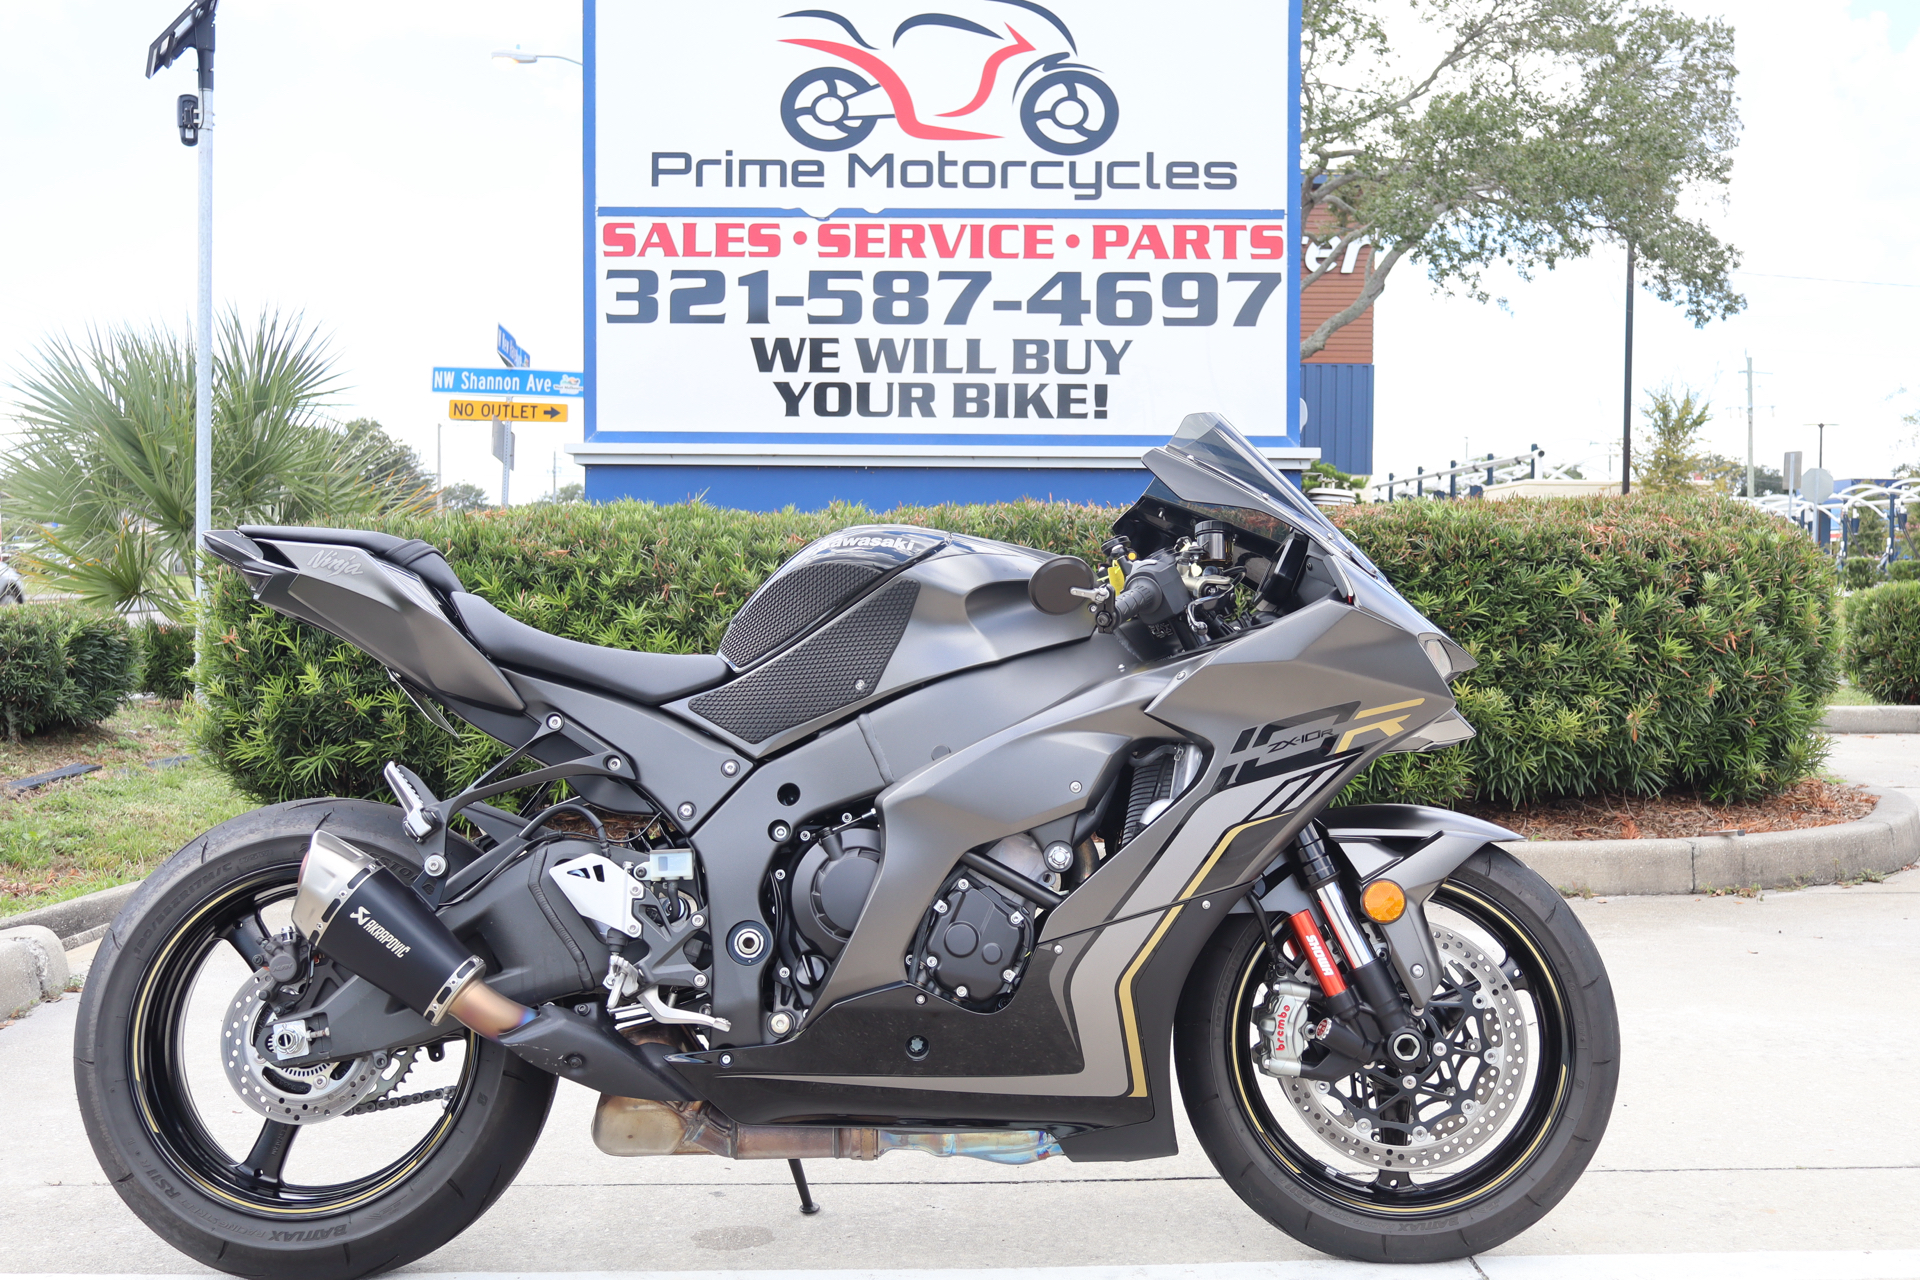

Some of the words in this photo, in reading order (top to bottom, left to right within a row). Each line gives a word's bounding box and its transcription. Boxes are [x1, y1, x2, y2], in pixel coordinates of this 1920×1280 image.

[651, 150, 826, 188] Prime
[847, 151, 1238, 200] Motorcycles
[602, 222, 781, 258] SALES
[817, 223, 1055, 259] SERVICE
[1092, 224, 1284, 260] PARTS
[605, 269, 1282, 327] 321-587-4697
[750, 337, 841, 374] WE
[855, 337, 997, 374] WILL
[1012, 338, 1134, 376] BUY
[434, 370, 455, 389] NW
[461, 371, 520, 392] Shannon
[526, 373, 551, 393] Ave
[773, 381, 937, 418] YOUR
[952, 382, 1109, 420] BIKE!
[453, 402, 474, 417] NO
[481, 403, 538, 419] OUTLET
[818, 536, 915, 552] awasaki
[306, 549, 364, 578] Ninja
[1267, 728, 1334, 754] ZX-10R
[1305, 934, 1335, 976] SHOWA
[1276, 1005, 1290, 1051] brembo
